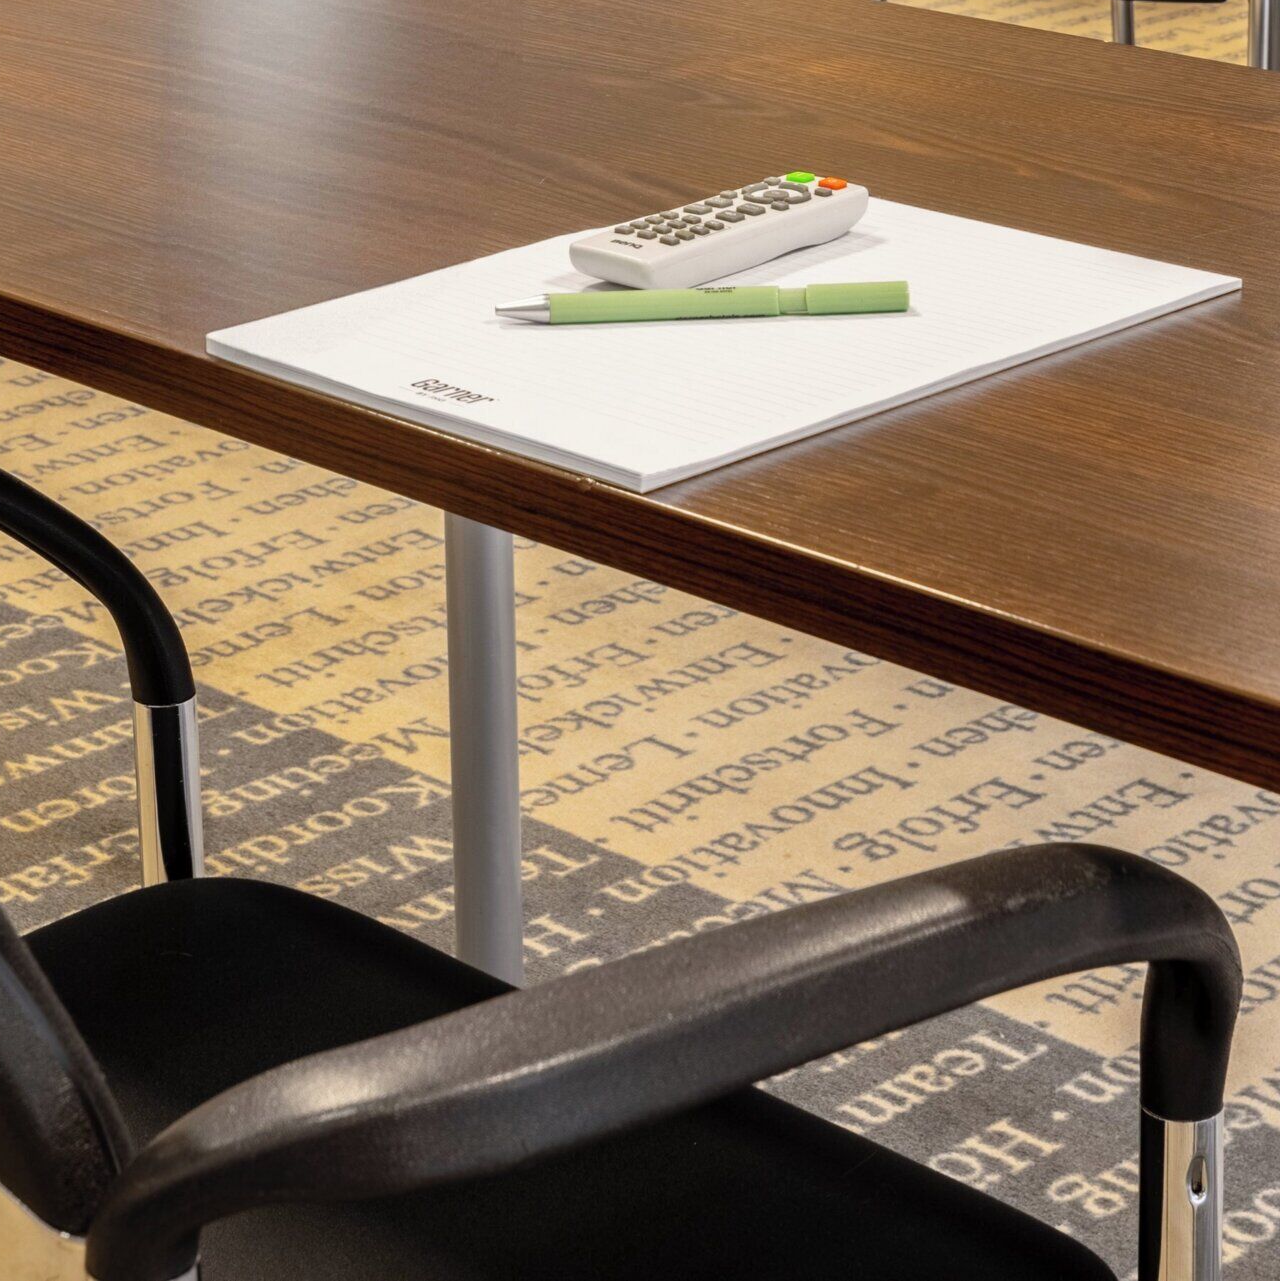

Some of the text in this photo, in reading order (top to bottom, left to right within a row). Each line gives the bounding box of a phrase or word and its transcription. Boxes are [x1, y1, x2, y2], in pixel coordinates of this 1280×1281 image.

[410, 378, 494, 404] Garner
[181, 717, 461, 817] Meeting
[602, 707, 905, 838] Fortschritt
[594, 764, 920, 903] Innovation
[824, 776, 1051, 864] Erfolg
